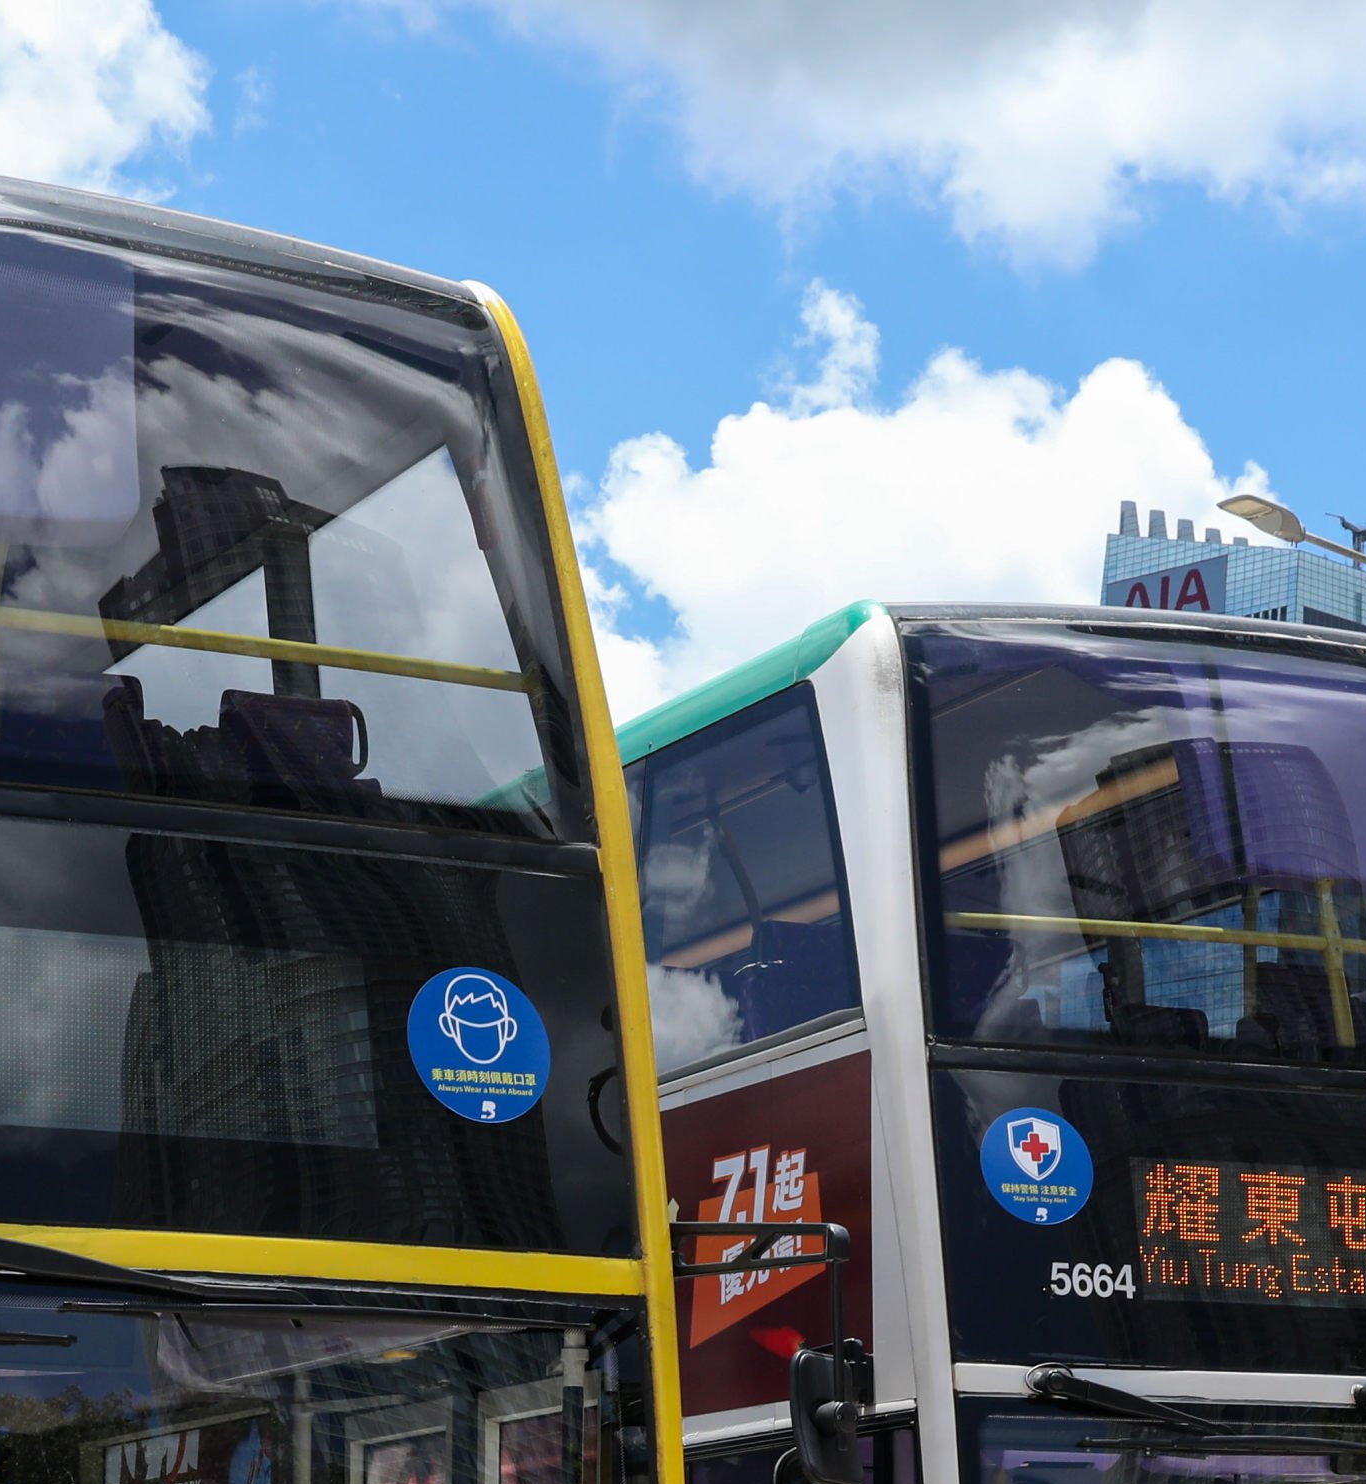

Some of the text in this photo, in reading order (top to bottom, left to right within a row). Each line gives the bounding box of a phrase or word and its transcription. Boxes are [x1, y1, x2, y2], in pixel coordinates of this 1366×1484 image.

[438, 1084, 463, 1093] Always
[489, 1087, 506, 1095] Mask
[508, 1088, 533, 1096] Aboard
[1041, 1185, 1077, 1196] 注意安全
[1050, 1262, 1136, 1299] 5664
[1139, 1245, 1190, 1285] Yiu
[1198, 1249, 1283, 1299] Tung
